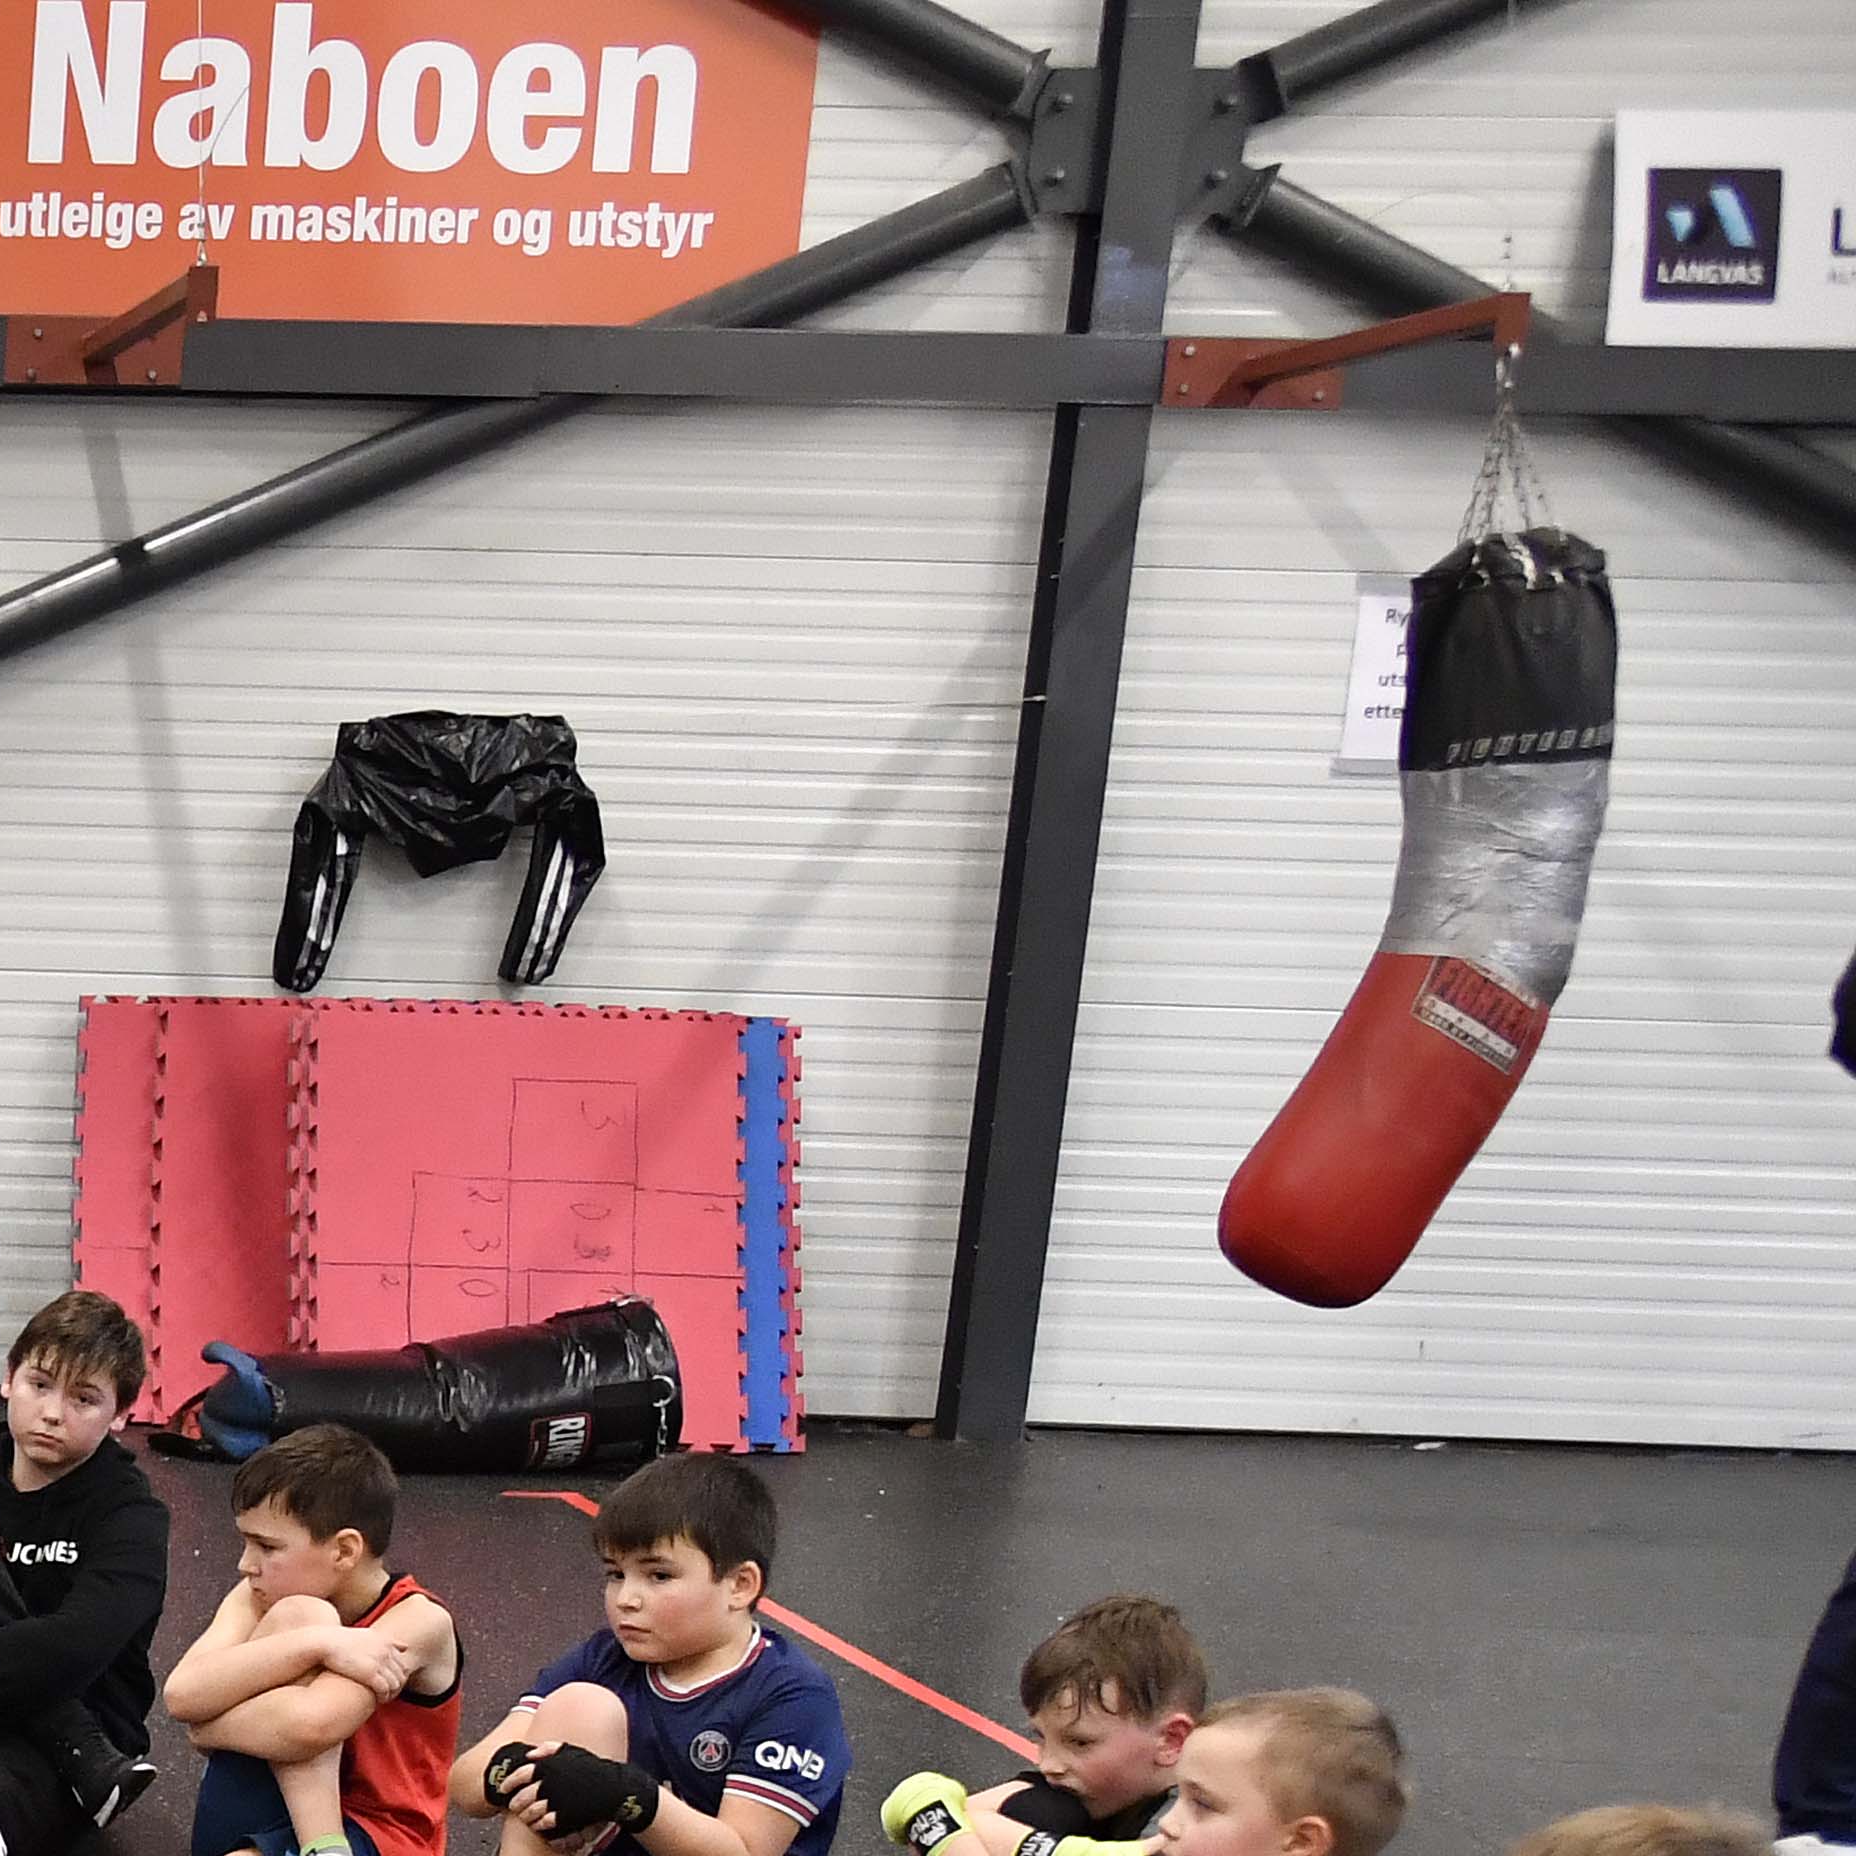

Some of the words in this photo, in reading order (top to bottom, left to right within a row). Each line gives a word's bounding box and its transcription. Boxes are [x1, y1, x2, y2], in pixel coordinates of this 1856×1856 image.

[27, 0, 698, 174] Naboen
[178, 202, 235, 241] av
[250, 197, 479, 244] maskiner
[492, 206, 551, 257] og
[568, 202, 714, 258] utstyr
[1385, 607, 1411, 628] Ry
[1363, 704, 1404, 720] ette
[754, 1740, 826, 1781] QNB
